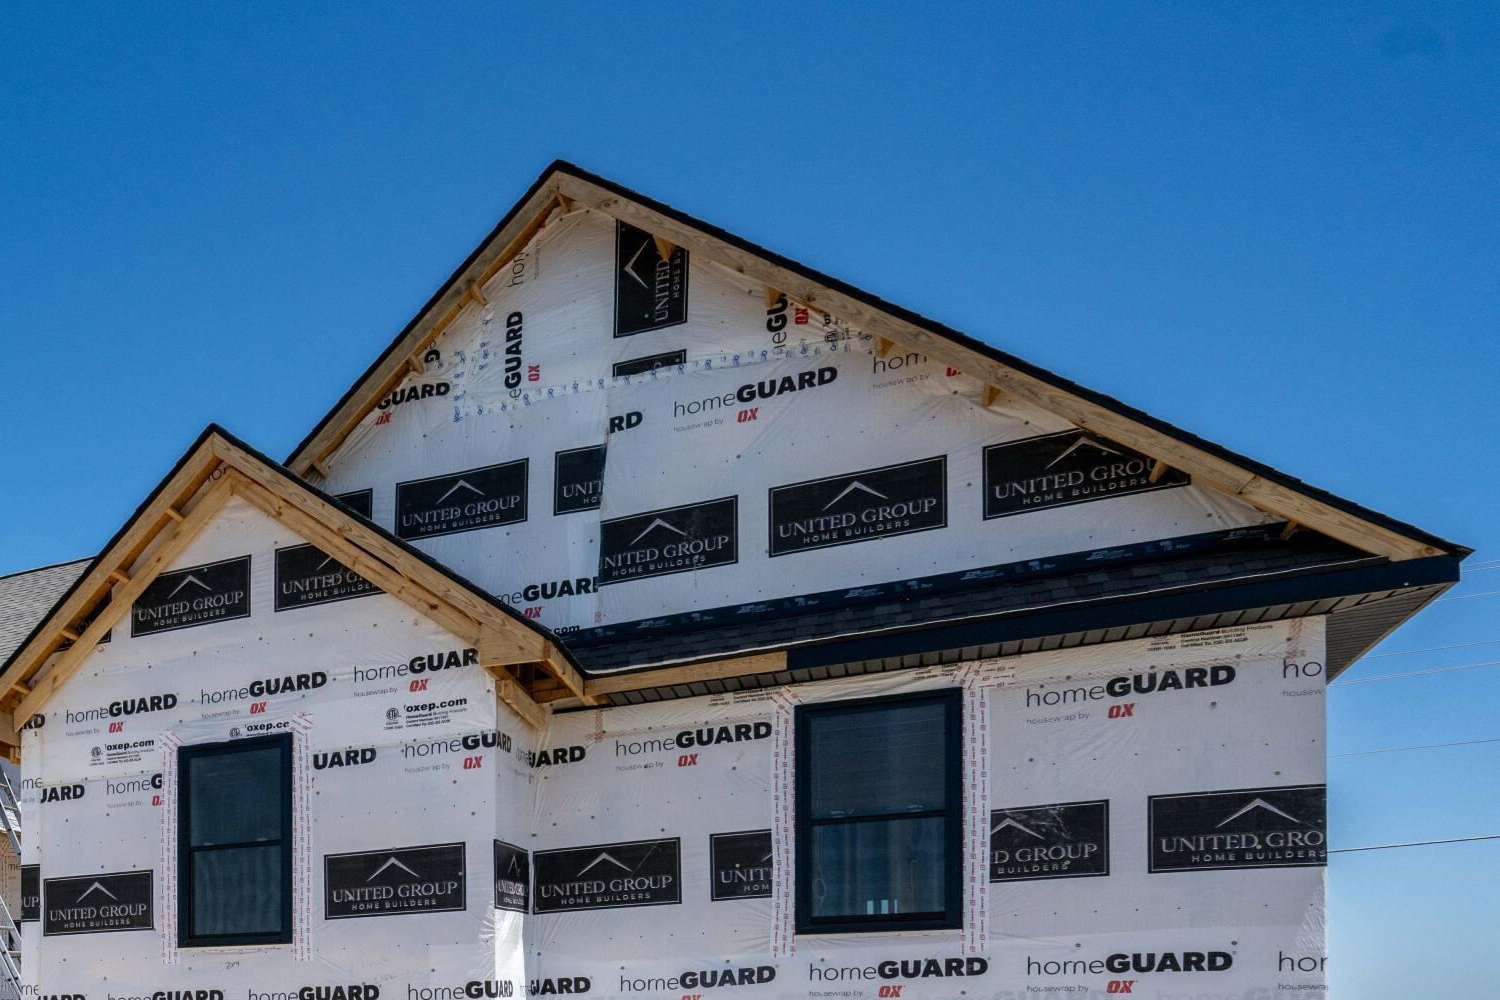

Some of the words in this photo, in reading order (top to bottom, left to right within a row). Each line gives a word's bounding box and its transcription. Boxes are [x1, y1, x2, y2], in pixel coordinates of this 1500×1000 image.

[528, 363, 540, 382] OX
[673, 366, 839, 418] homeGUARD
[737, 407, 758, 424] OX
[995, 470, 1085, 500] UNITED
[1022, 491, 1064, 506] HOME
[1072, 477, 1148, 497] BUILDERS
[402, 506, 460, 528] UNITED
[464, 495, 520, 515] GROUP
[779, 512, 857, 539] UNITED
[861, 498, 938, 525] GROUP
[420, 523, 448, 534] HOME
[452, 513, 501, 529] BUILDERS
[803, 530, 839, 545] HOME
[845, 519, 910, 537] BUILDERS
[663, 535, 730, 559] GROUP
[612, 565, 643, 577] HOME
[282, 573, 342, 595] UNITED
[301, 588, 329, 601] HOME
[137, 601, 189, 622] UNITED
[193, 591, 244, 611] GROUP
[522, 606, 544, 620] OX
[153, 617, 178, 628] HOME
[182, 607, 227, 623] BUILDERS
[200, 671, 327, 706] homeGUARD
[409, 679, 430, 692] OX
[1025, 665, 1236, 709] homeGUARD
[65, 693, 178, 725] homeGUARD
[249, 701, 267, 714] OX
[406, 697, 468, 714] oxep.com
[1107, 702, 1136, 719] OX
[108, 721, 124, 734] OX
[106, 740, 155, 752] oxep.com
[615, 720, 773, 757] homeGUARD
[463, 756, 484, 770] OX
[677, 753, 699, 768] OX
[1015, 842, 1098, 864] GROUP
[1161, 834, 1258, 854] UNITED
[1192, 852, 1237, 863] HOME
[998, 862, 1069, 875] BUILDERS
[333, 887, 394, 904] UNITED
[398, 880, 458, 898] GROUP
[541, 880, 606, 898] UNITED
[610, 875, 673, 893] GROUP
[351, 902, 380, 911] HOME
[385, 899, 437, 909] BUILDERS
[561, 898, 590, 906] HOME
[596, 892, 651, 904] BUILDERS
[50, 907, 97, 922] UNITED
[100, 902, 147, 918] GROUP
[90, 918, 131, 928] BUILDERS
[809, 957, 989, 982] homeGUARD
[1027, 951, 1235, 976] homeGUARD
[620, 965, 776, 992] homeGUARD
[1107, 980, 1134, 994] OX
[878, 984, 902, 998] OX
